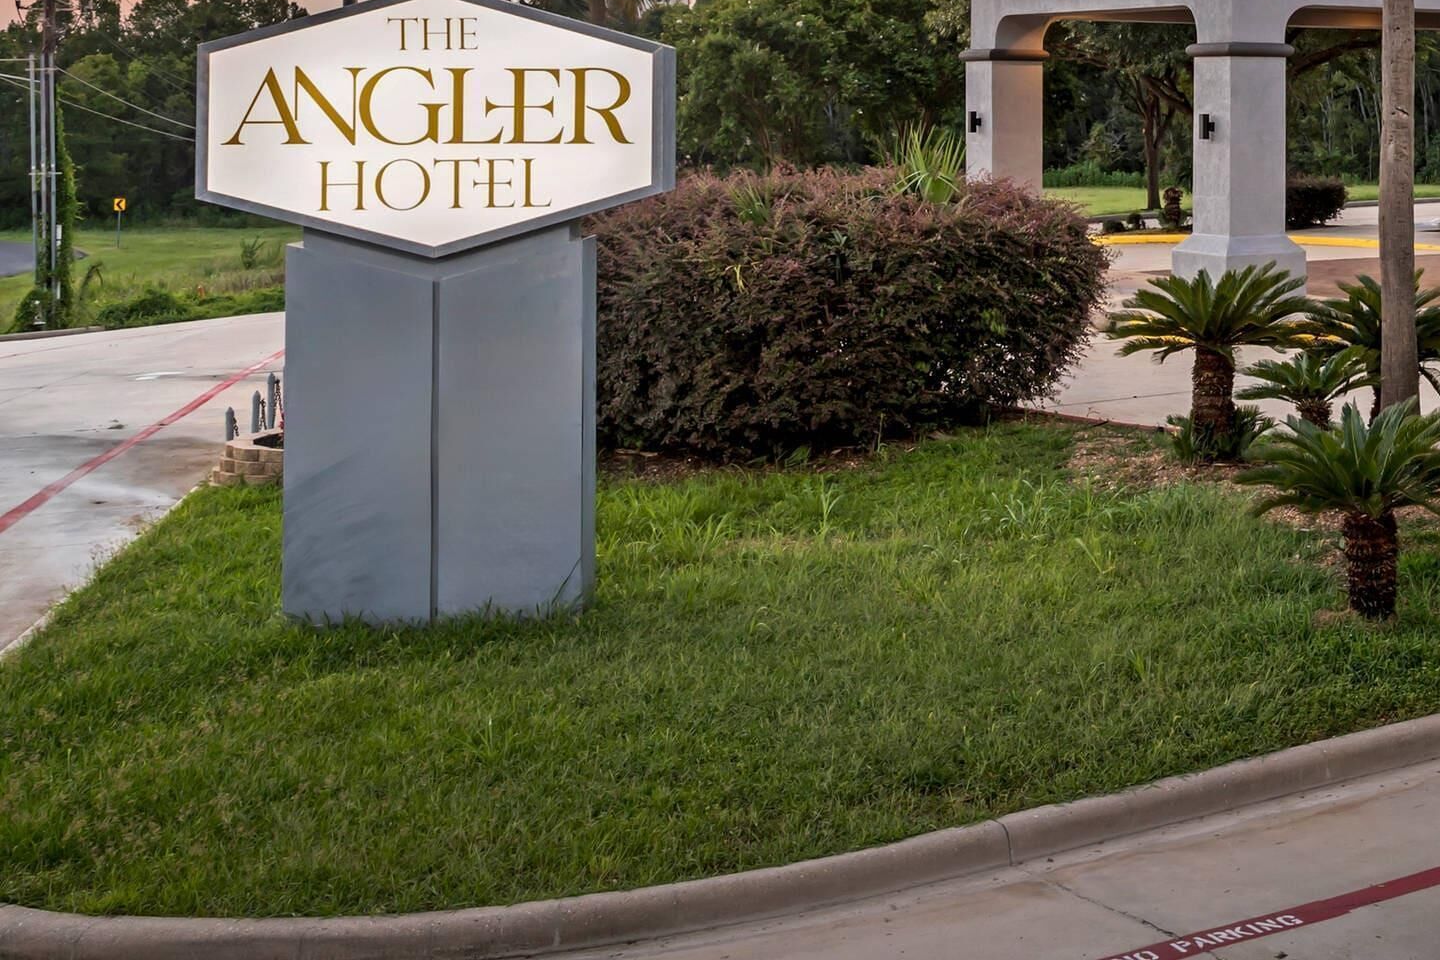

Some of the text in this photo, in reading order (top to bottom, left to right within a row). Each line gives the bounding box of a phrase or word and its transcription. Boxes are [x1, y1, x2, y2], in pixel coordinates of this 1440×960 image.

[386, 17, 479, 51] THE
[220, 66, 634, 146] ANGLER
[318, 157, 553, 212] HOTEL
[1170, 914, 1304, 953] PARKING
